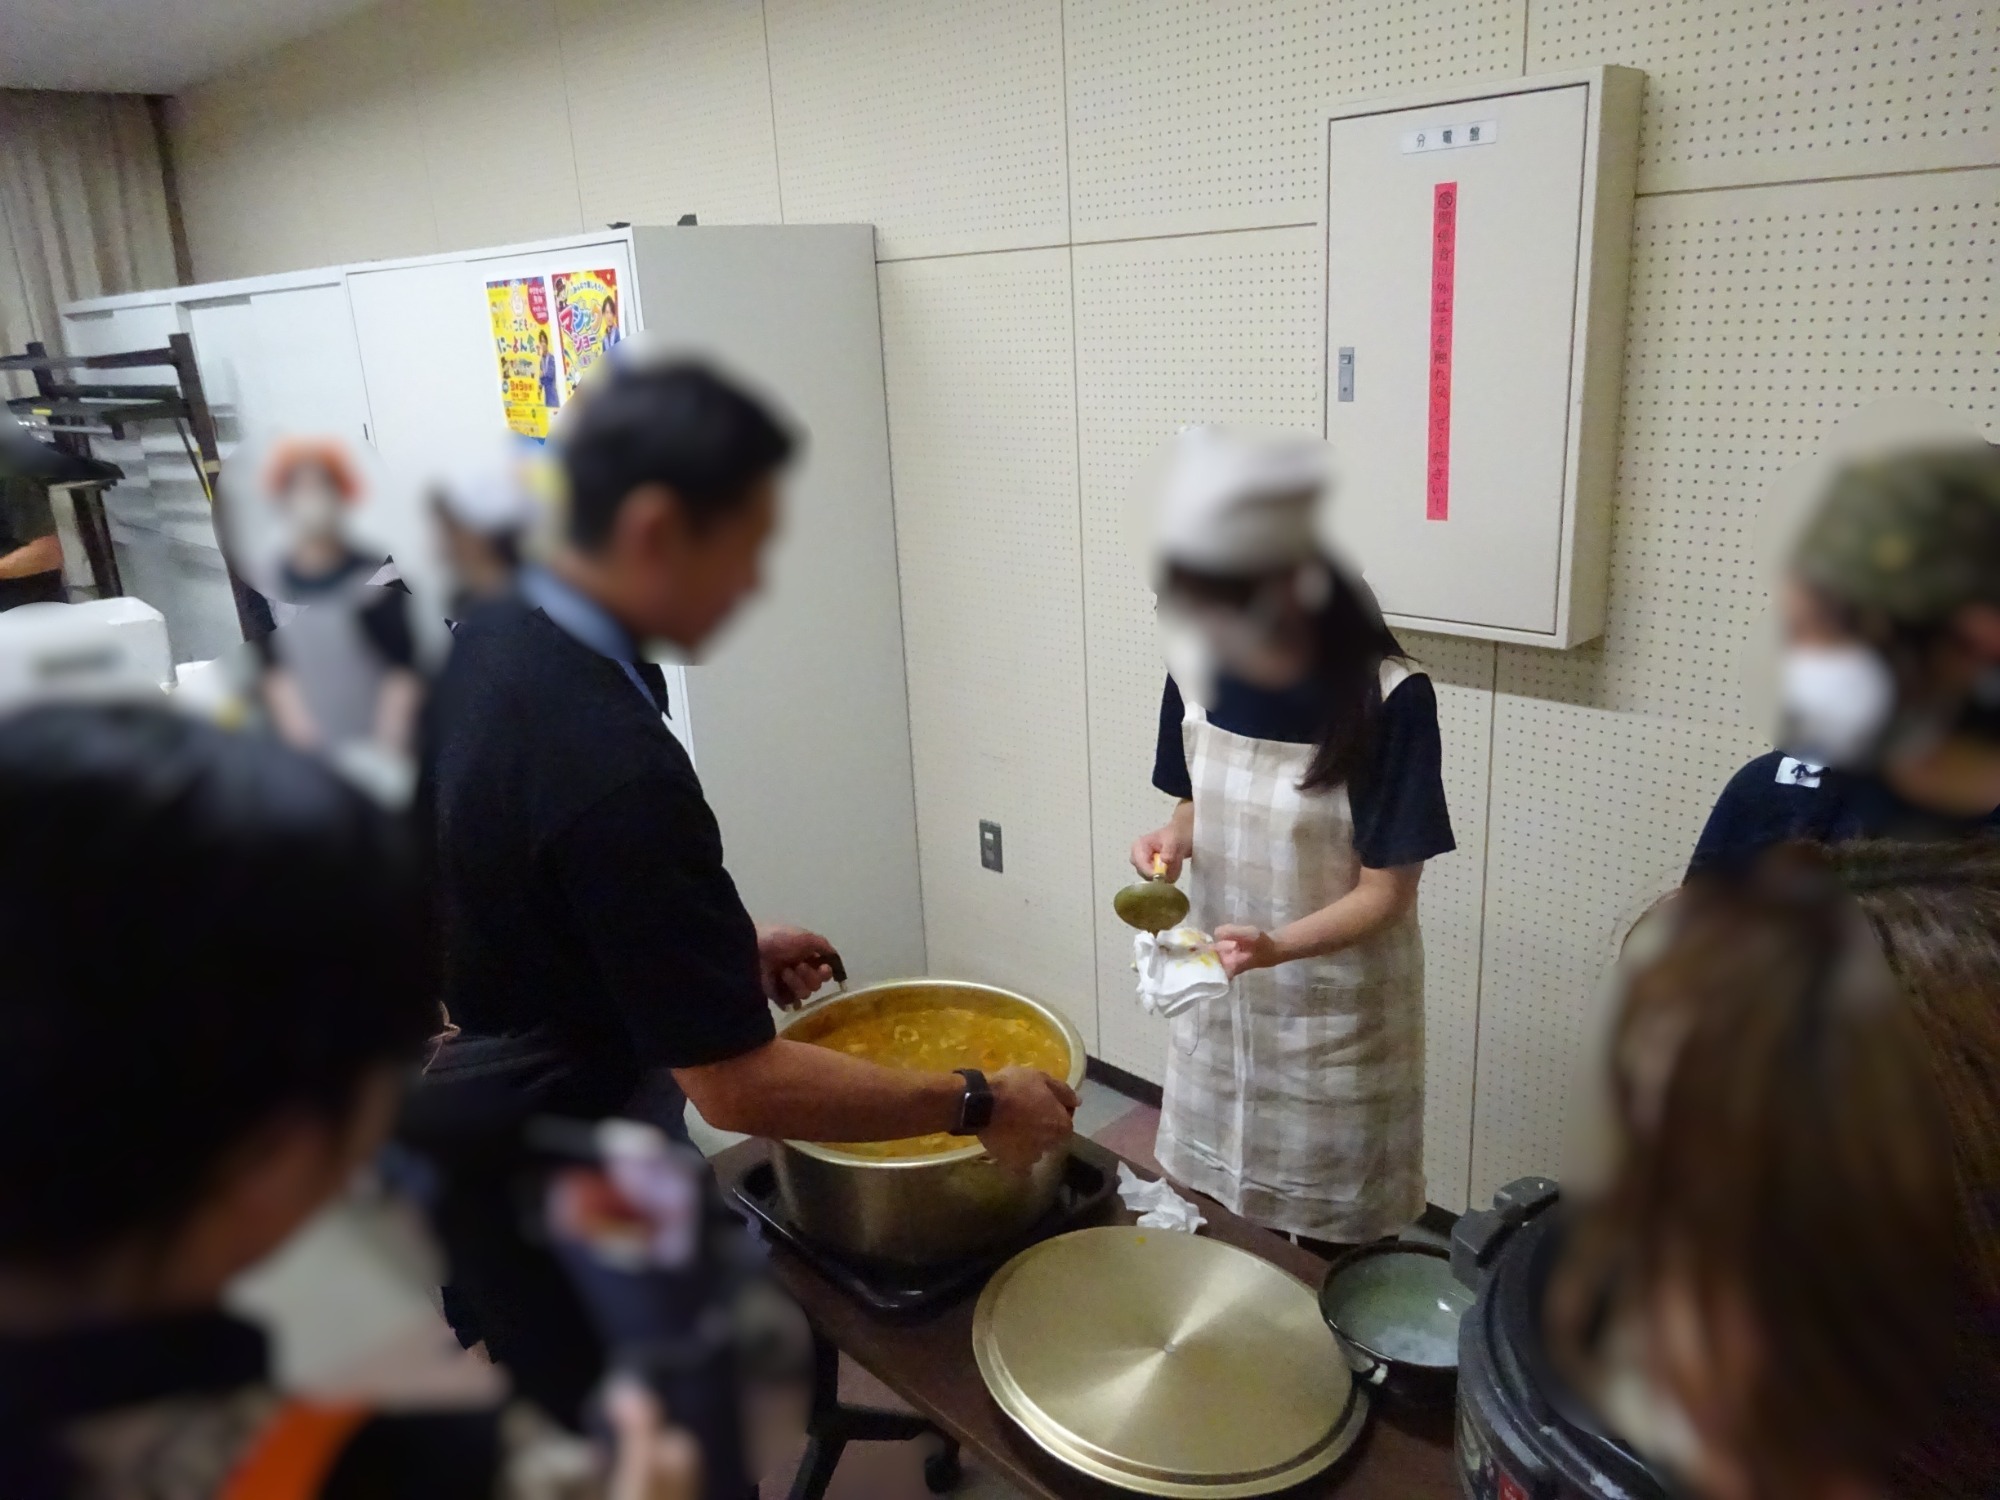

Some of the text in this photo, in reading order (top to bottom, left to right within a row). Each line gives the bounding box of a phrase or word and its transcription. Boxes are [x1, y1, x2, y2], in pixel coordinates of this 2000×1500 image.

[559, 306, 601, 337] マジック
[573, 333, 597, 356] ショー
